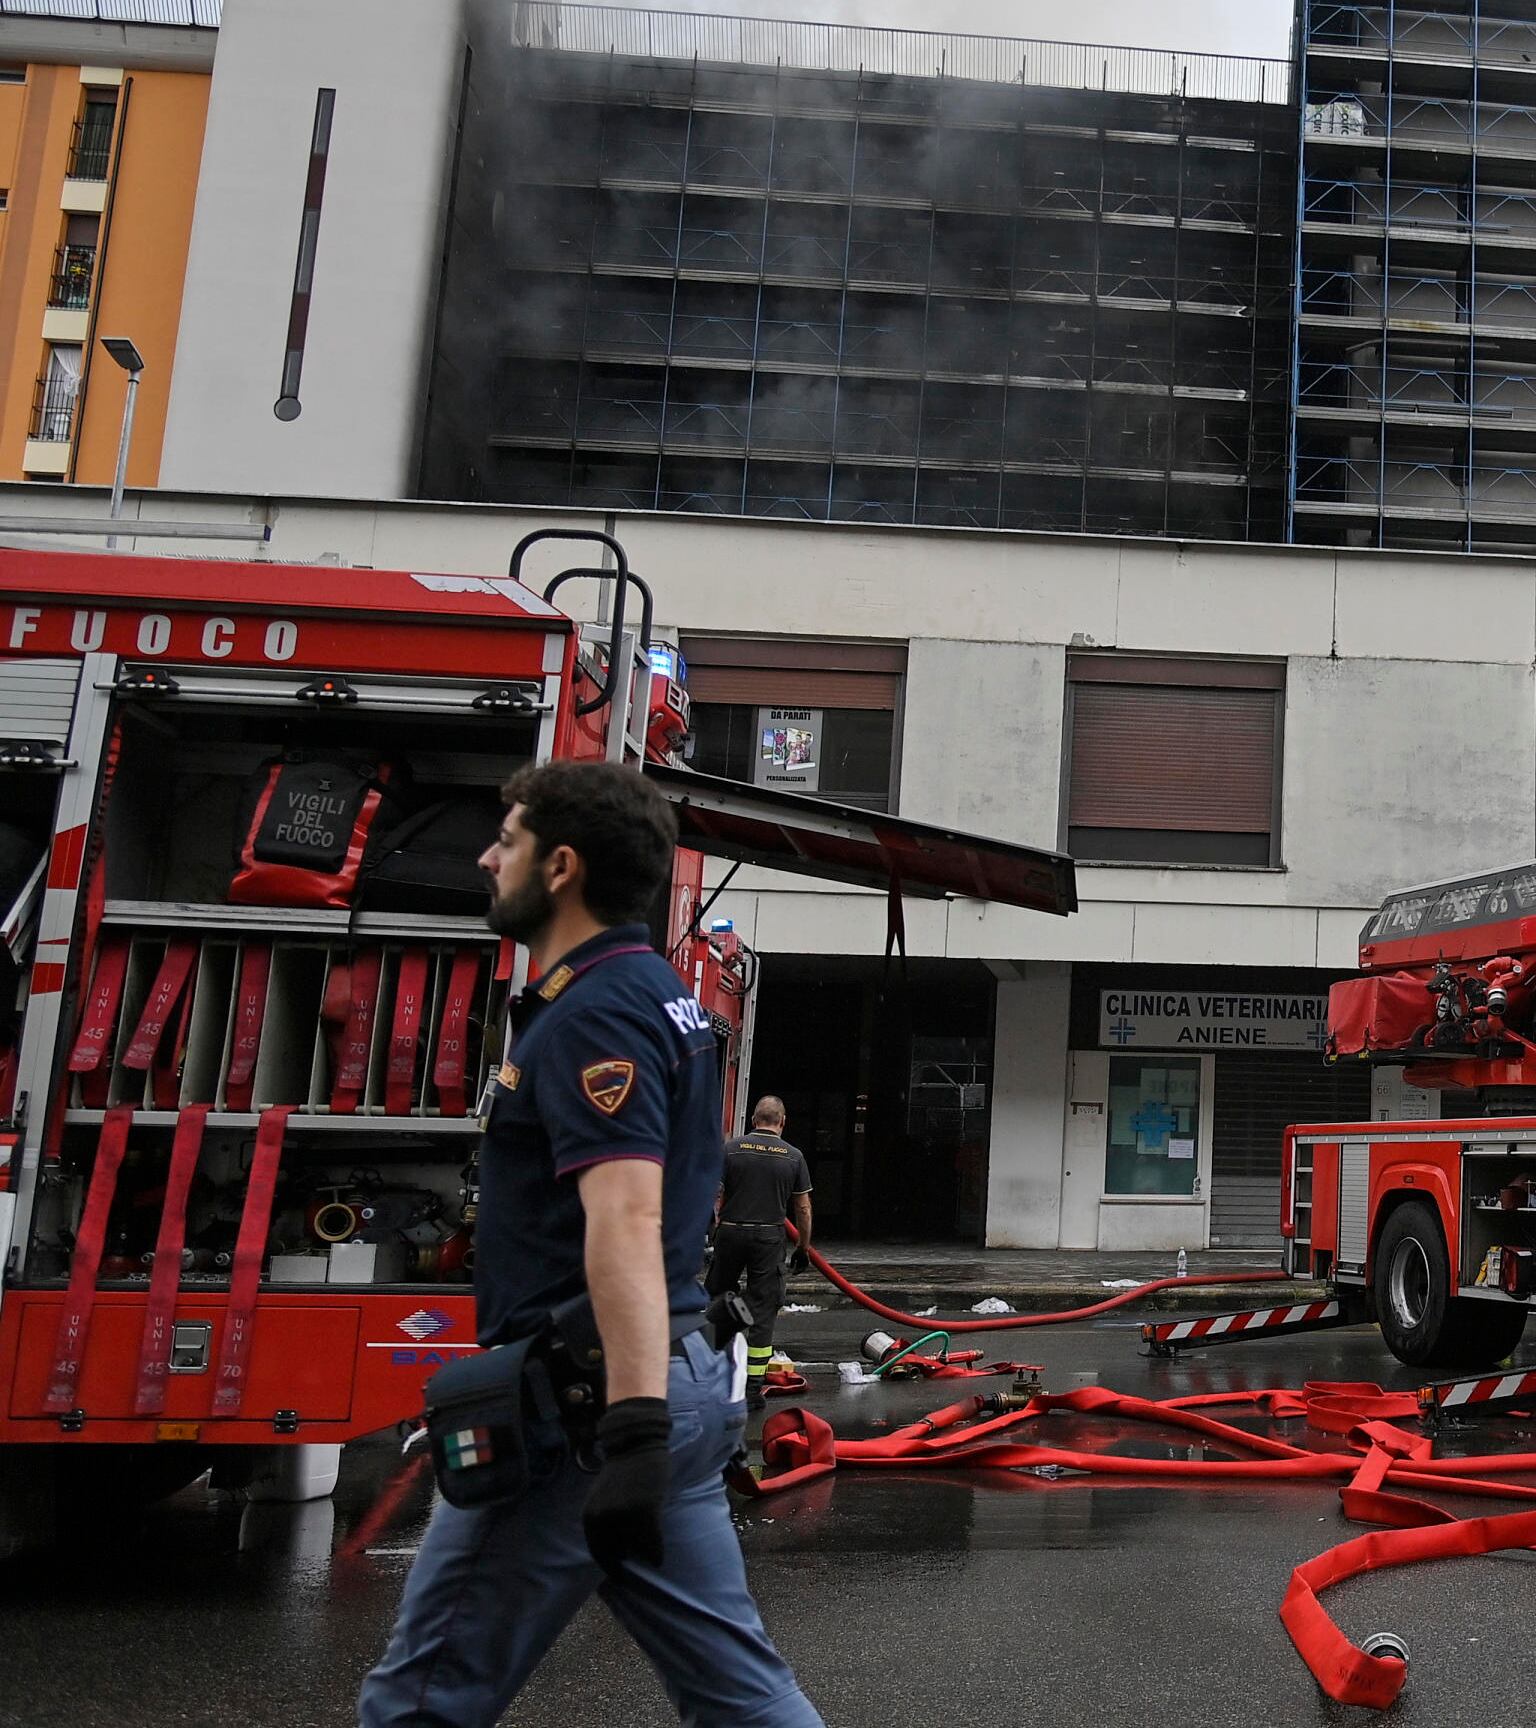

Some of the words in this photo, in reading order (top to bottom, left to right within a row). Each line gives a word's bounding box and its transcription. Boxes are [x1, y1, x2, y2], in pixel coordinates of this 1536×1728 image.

[9, 608, 299, 661] FUOCO
[784, 712, 811, 720] PARATI
[288, 791, 346, 815] VIGILI
[293, 809, 324, 829] DEL
[276, 823, 335, 848] FUOCO
[98, 987, 110, 1018] UNI
[156, 983, 172, 1014] UNI
[1106, 995, 1191, 1017] CLINICA
[246, 995, 256, 1025] UNI
[358, 1000, 368, 1032] UNI
[404, 995, 414, 1025] UNI
[451, 999, 462, 1030] UNI
[85, 1028, 105, 1039] 45
[141, 1022, 161, 1035] 45
[1177, 1027, 1267, 1045] ANIENE
[239, 1036, 256, 1049] 45
[350, 1042, 366, 1055] 70
[396, 1036, 413, 1048] 70
[443, 1040, 459, 1052] 70
[67, 1315, 80, 1350] UNI
[152, 1316, 163, 1350] UNI
[232, 1318, 243, 1353] UNI
[57, 1361, 76, 1374] 45
[143, 1362, 165, 1375] 45
[223, 1364, 241, 1377] 70
